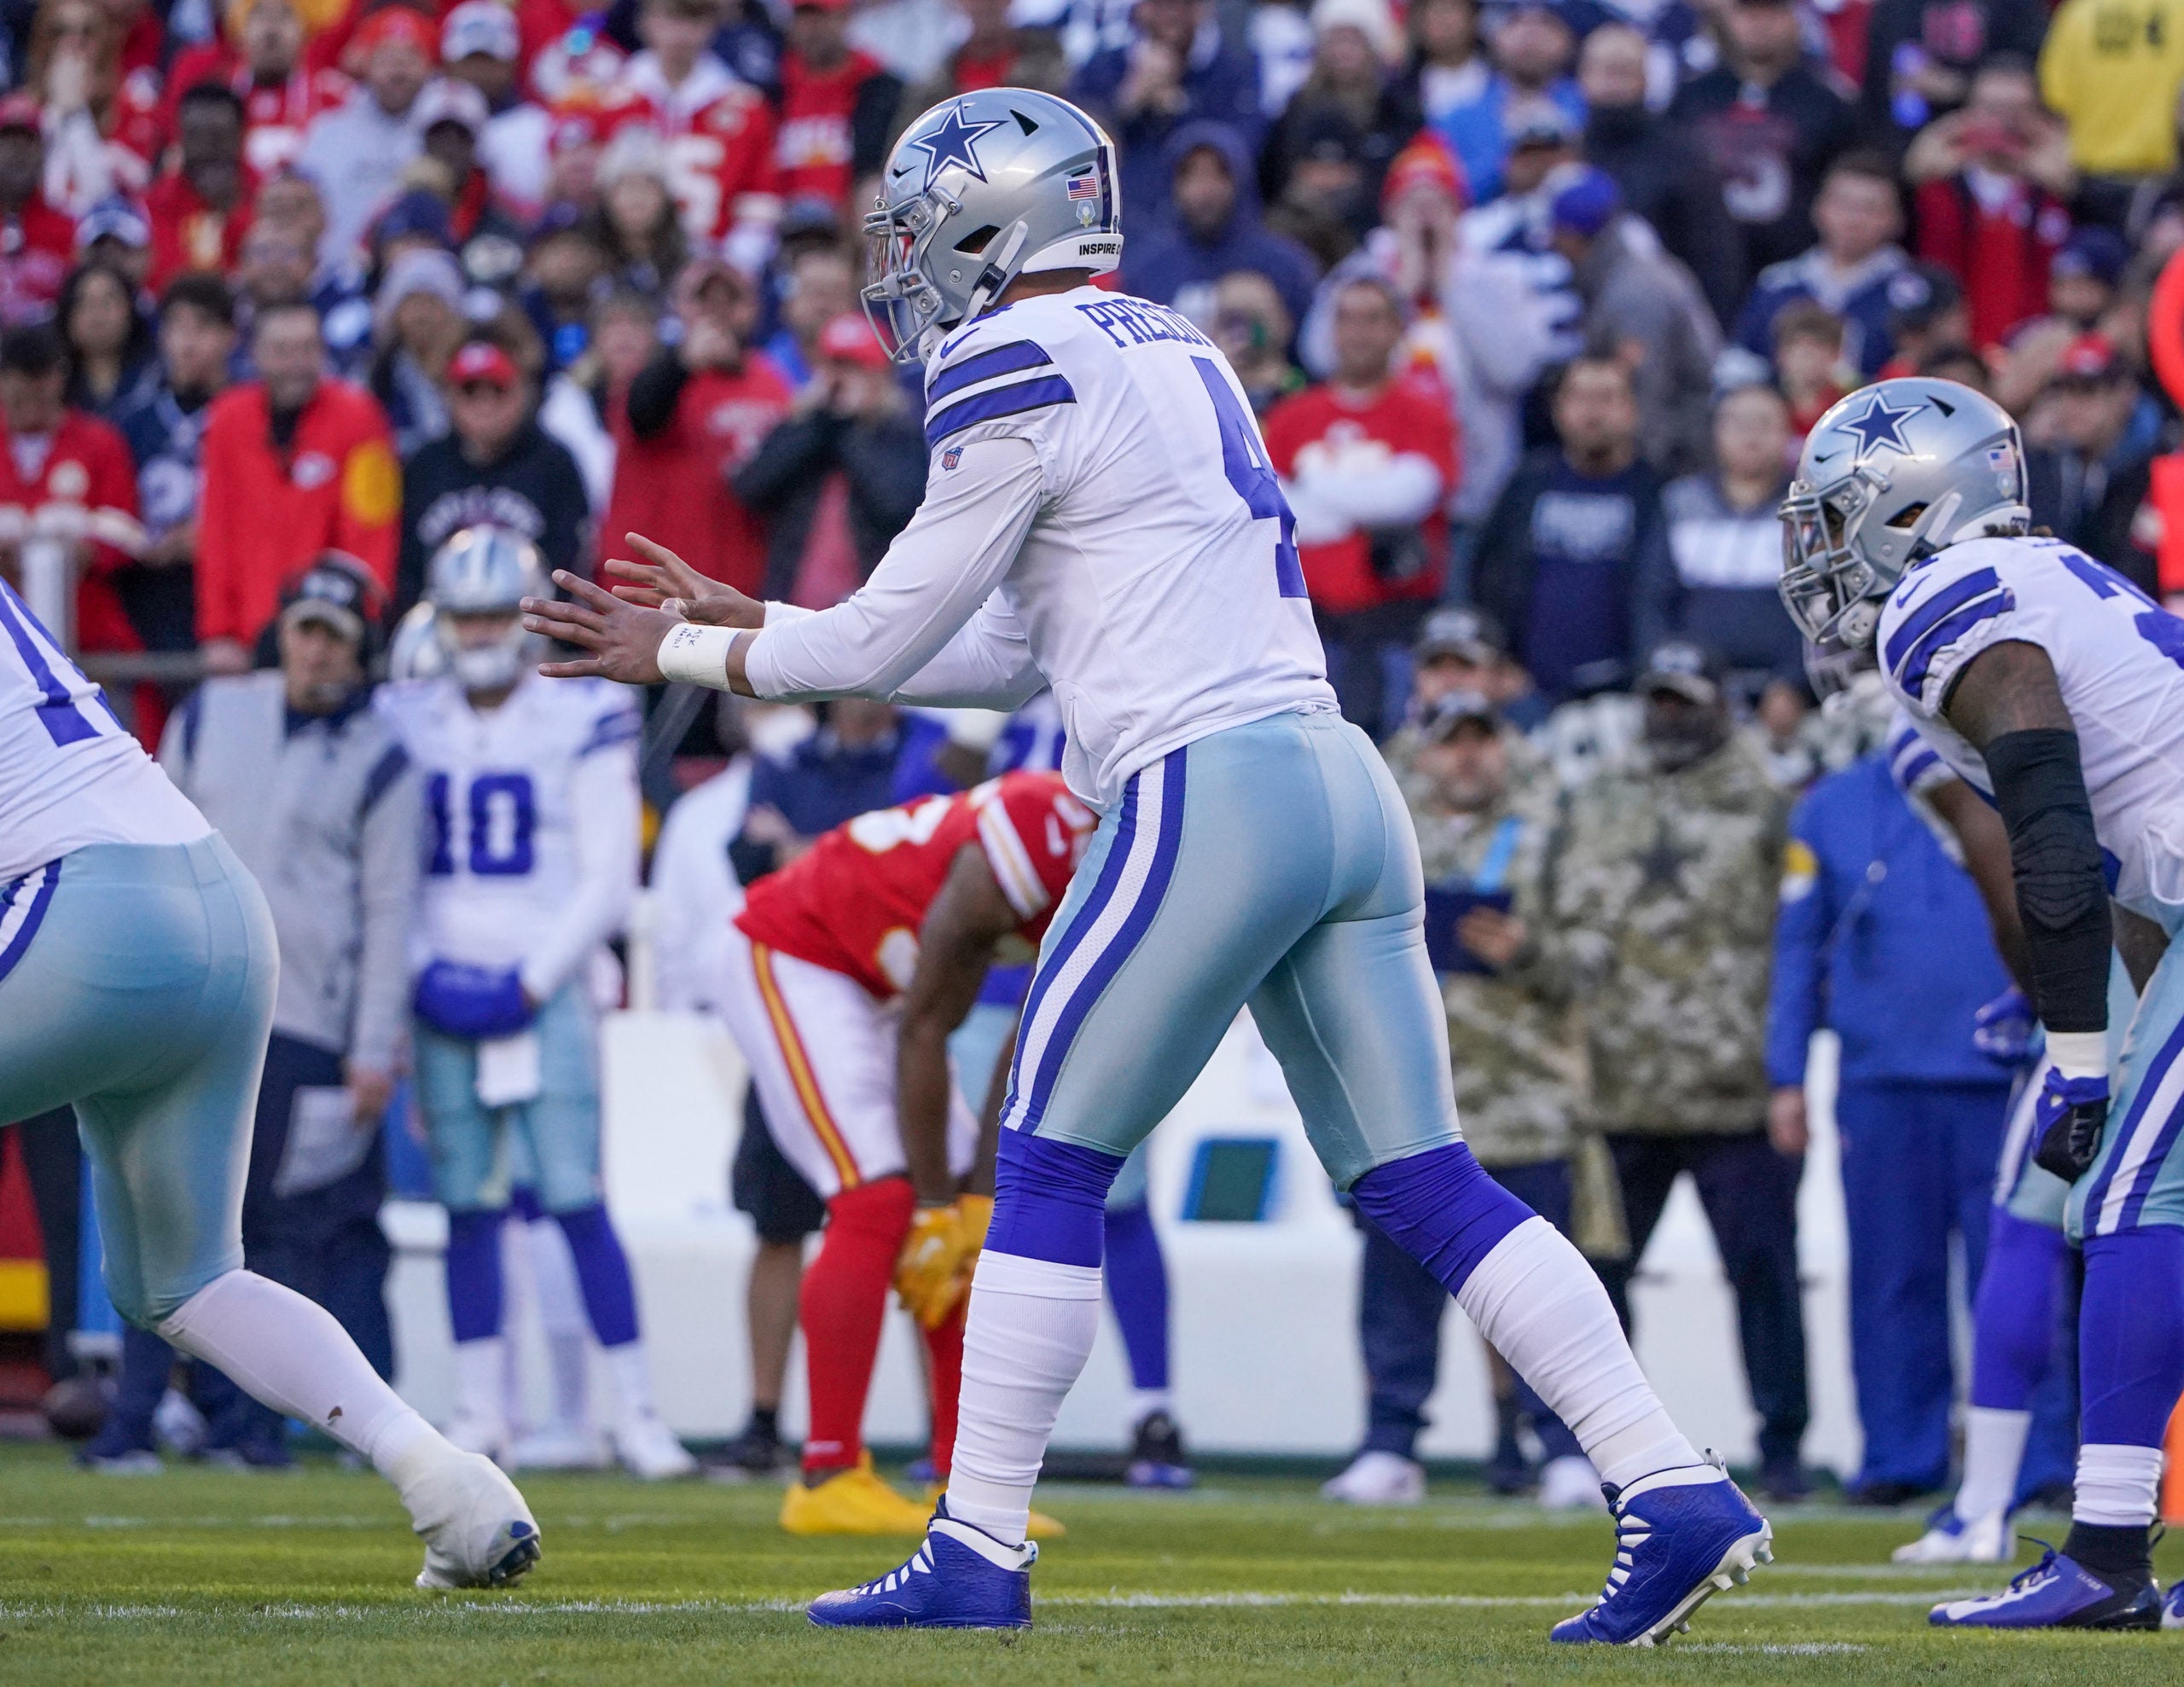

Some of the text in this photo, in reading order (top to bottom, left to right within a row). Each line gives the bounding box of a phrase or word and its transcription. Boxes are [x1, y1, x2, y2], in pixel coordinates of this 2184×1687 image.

[1079, 243, 1116, 256] INSPIRE
[1189, 355, 1310, 598] 4
[428, 773, 534, 875] 10
